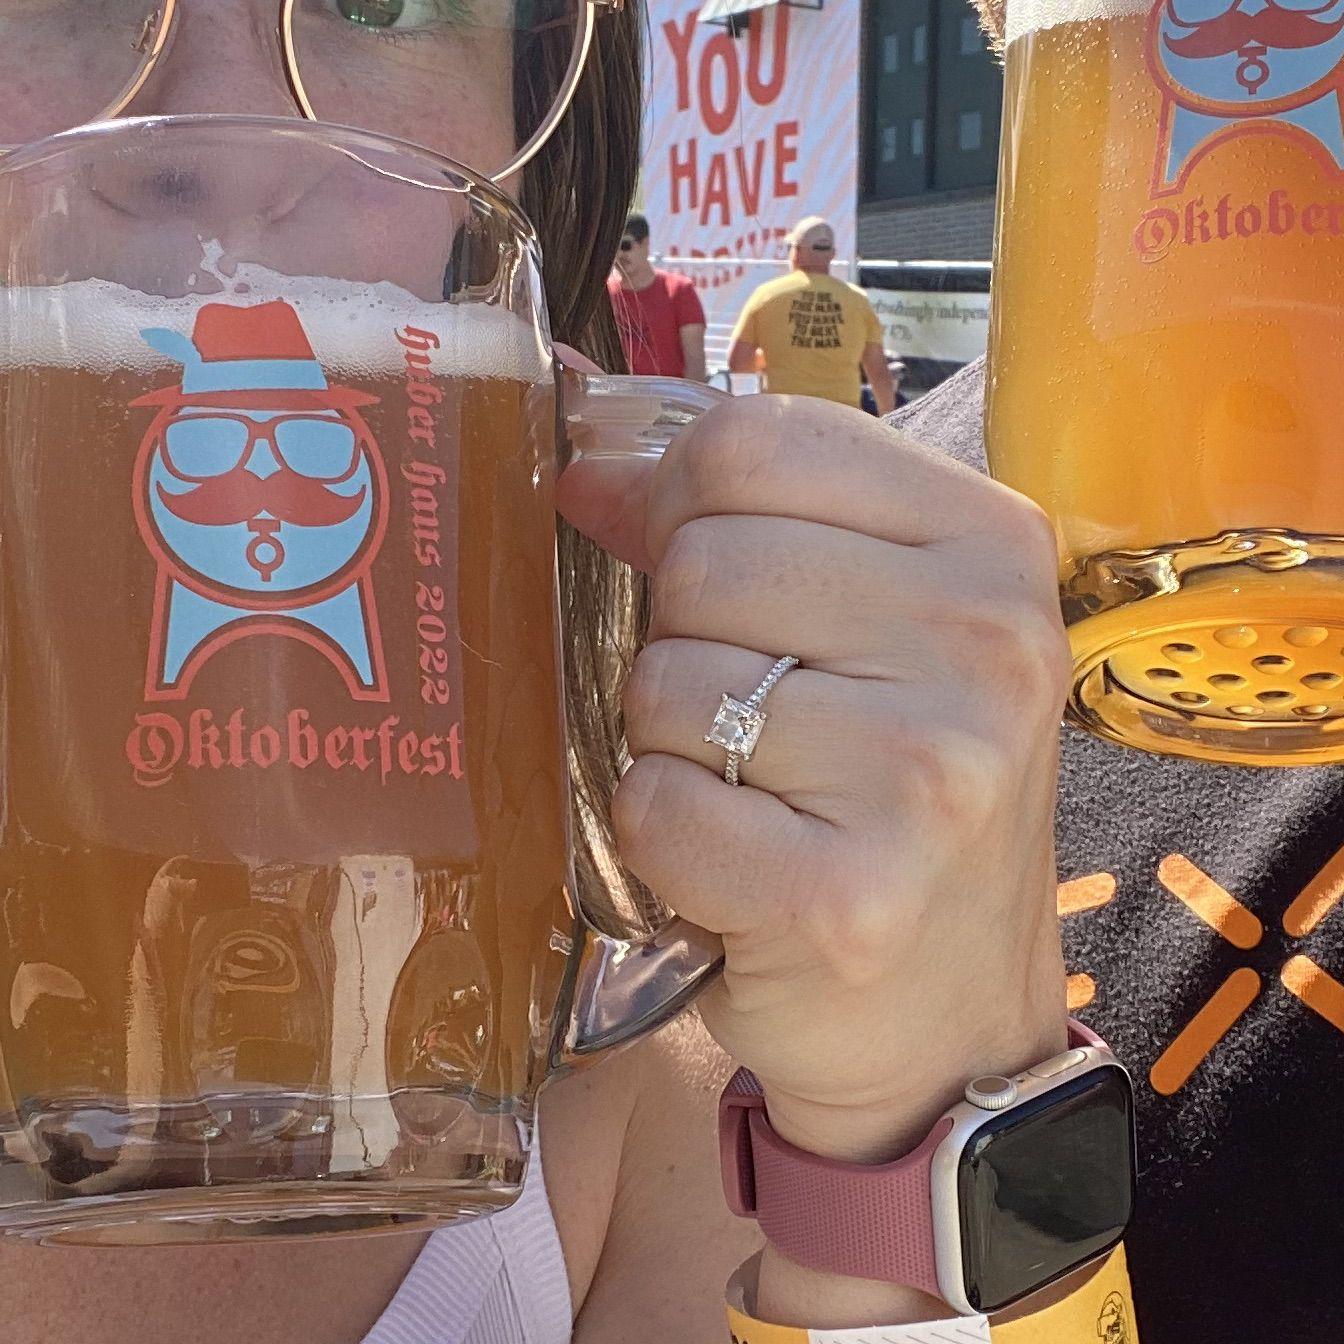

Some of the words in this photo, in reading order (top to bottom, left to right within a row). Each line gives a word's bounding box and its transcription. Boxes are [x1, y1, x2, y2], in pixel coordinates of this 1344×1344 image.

[669, 120, 799, 226] HAVE
[415, 580, 451, 706] 2022
[125, 708, 464, 787] Oktoberfest
